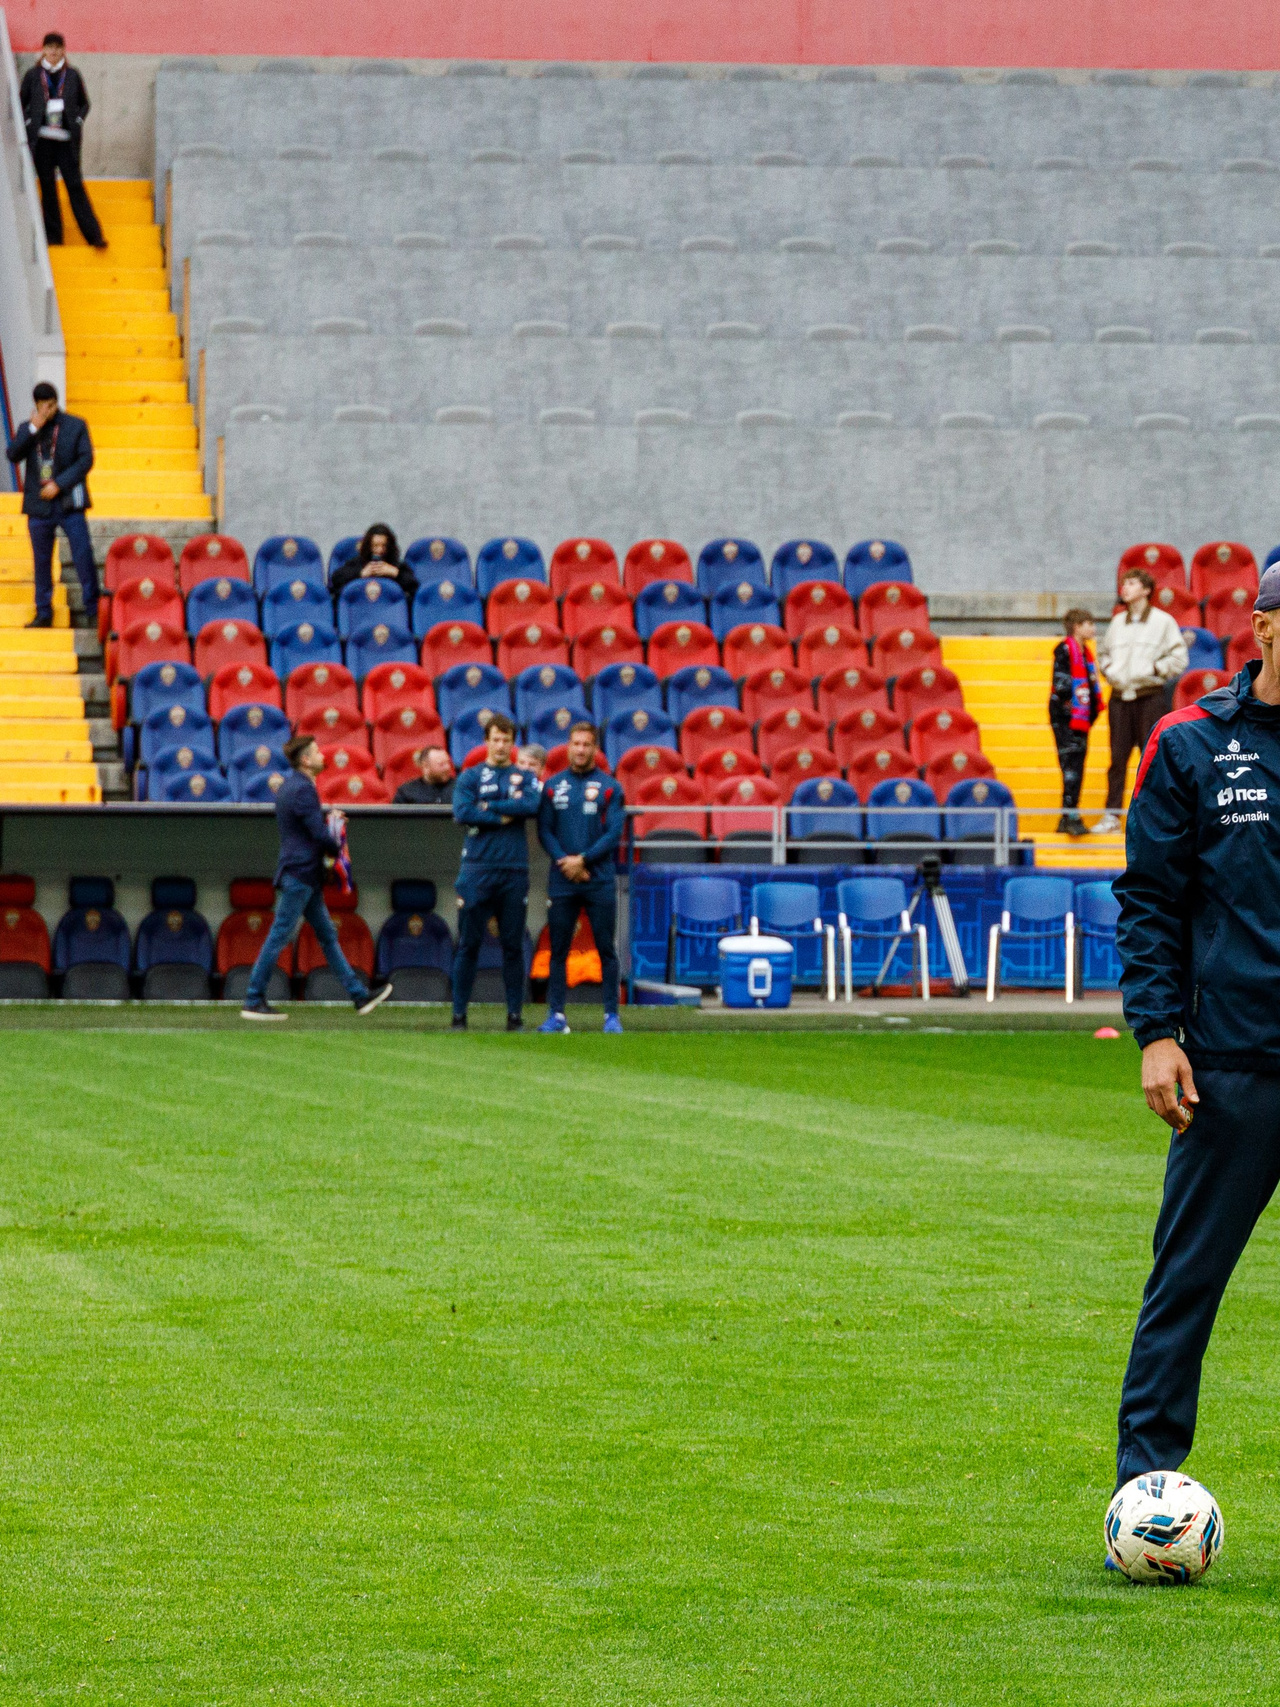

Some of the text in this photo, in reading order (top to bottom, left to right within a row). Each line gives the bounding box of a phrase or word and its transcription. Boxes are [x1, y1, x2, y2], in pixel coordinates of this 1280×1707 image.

[1213, 752, 1260, 762] APOTHEKA
[1235, 788, 1268, 801] ПСБ
[1231, 811, 1270, 823] билайн
